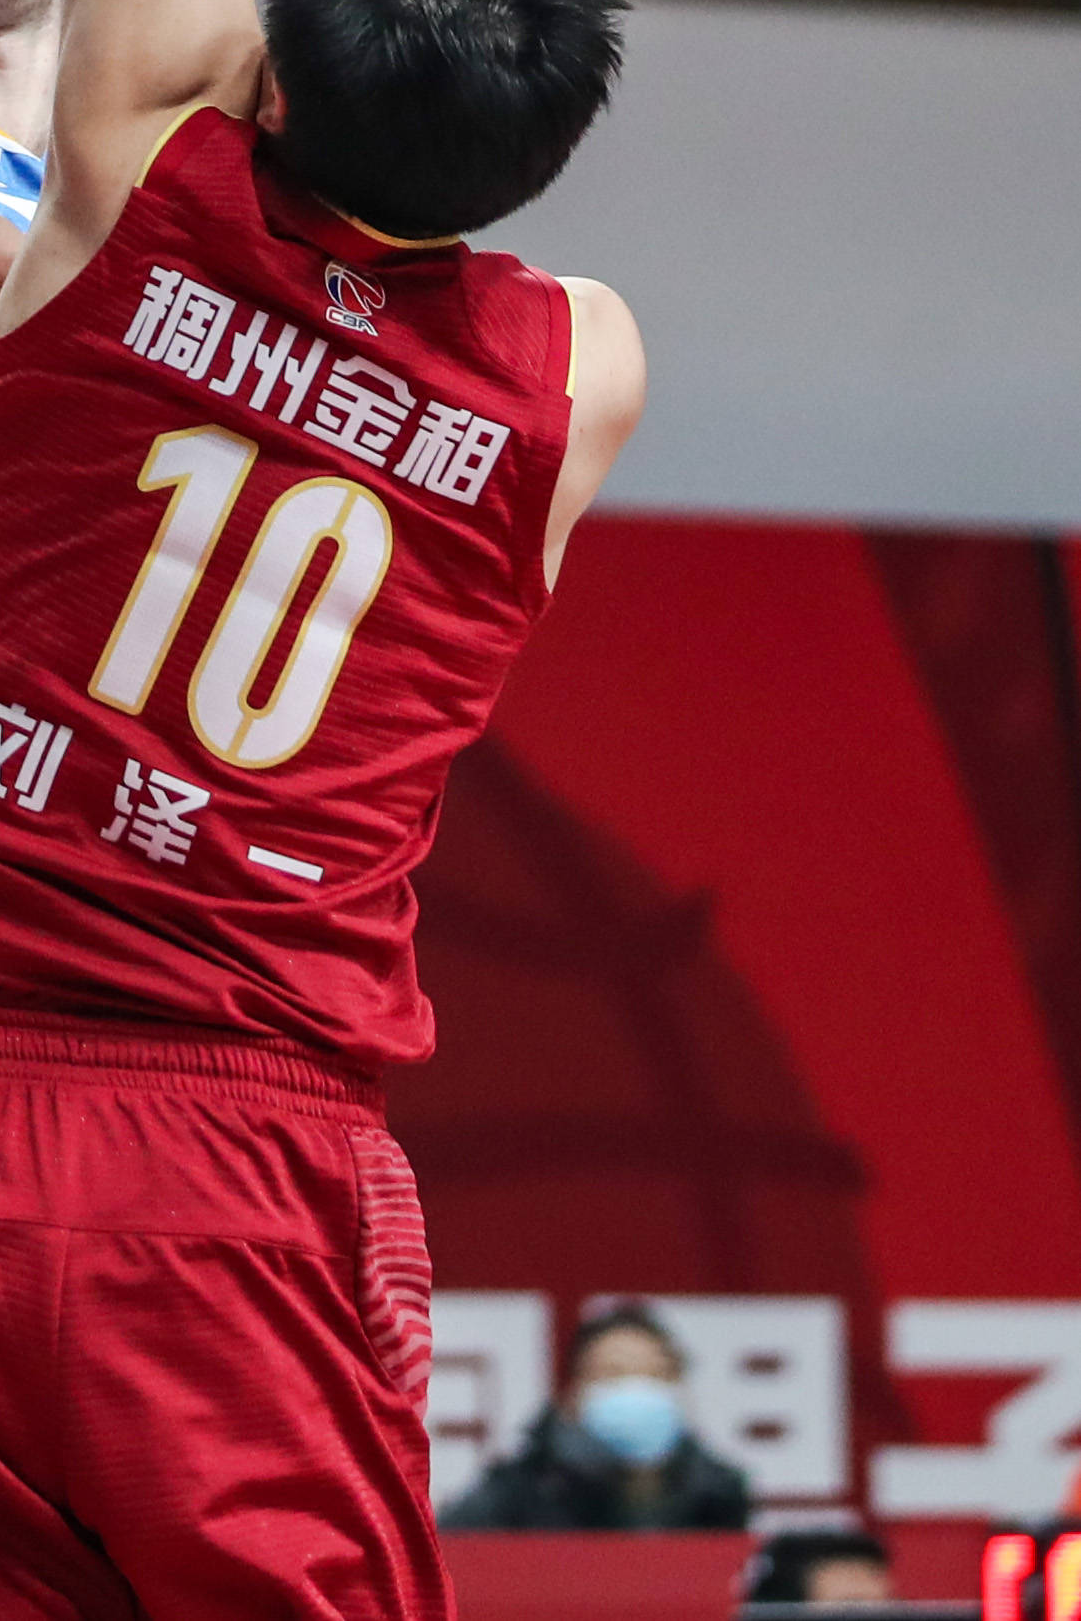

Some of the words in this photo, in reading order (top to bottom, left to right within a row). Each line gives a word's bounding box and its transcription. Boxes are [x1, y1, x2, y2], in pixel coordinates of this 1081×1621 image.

[123, 265, 511, 505] 稠州金租
[326, 305, 379, 337] CBA
[87, 424, 393, 769] 10
